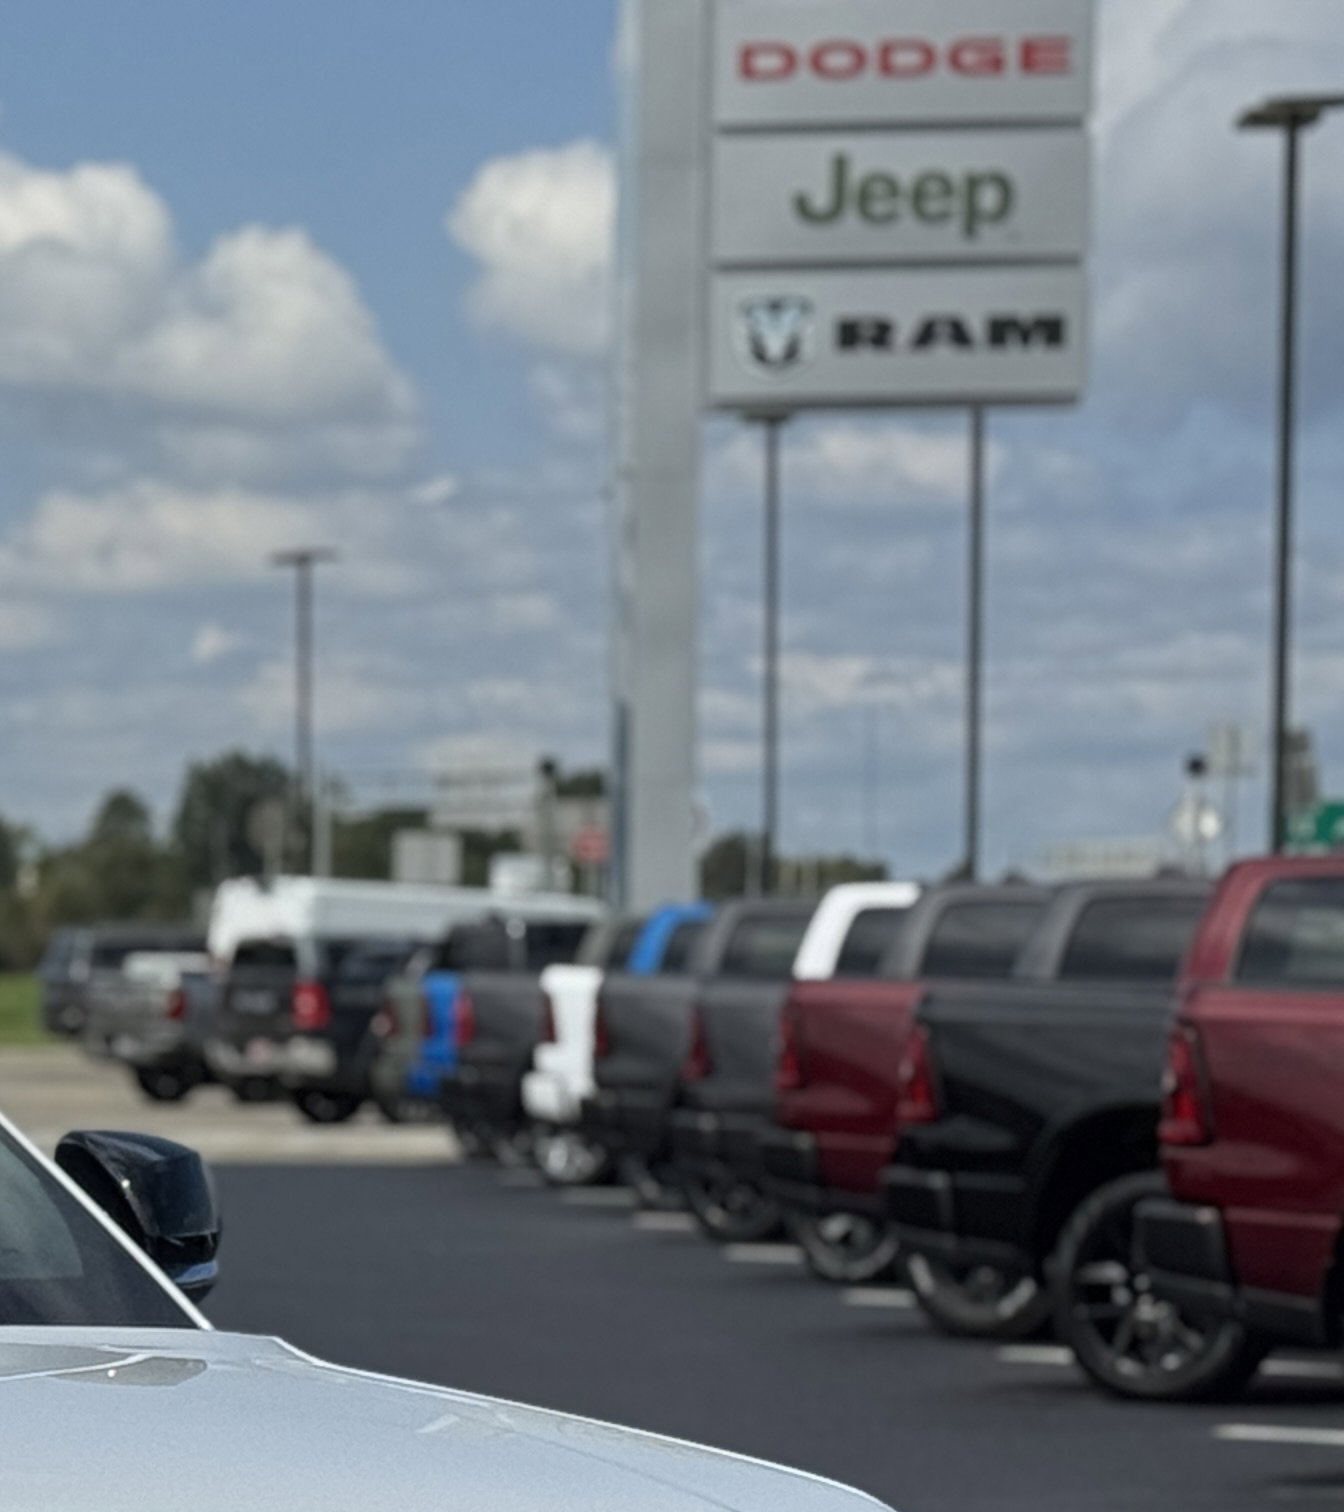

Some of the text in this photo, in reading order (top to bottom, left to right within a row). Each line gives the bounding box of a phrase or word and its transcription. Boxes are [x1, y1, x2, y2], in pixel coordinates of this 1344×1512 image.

[737, 37, 1072, 82] DODGE
[792, 152, 1017, 240] Jeep
[834, 313, 1068, 354] RAM
